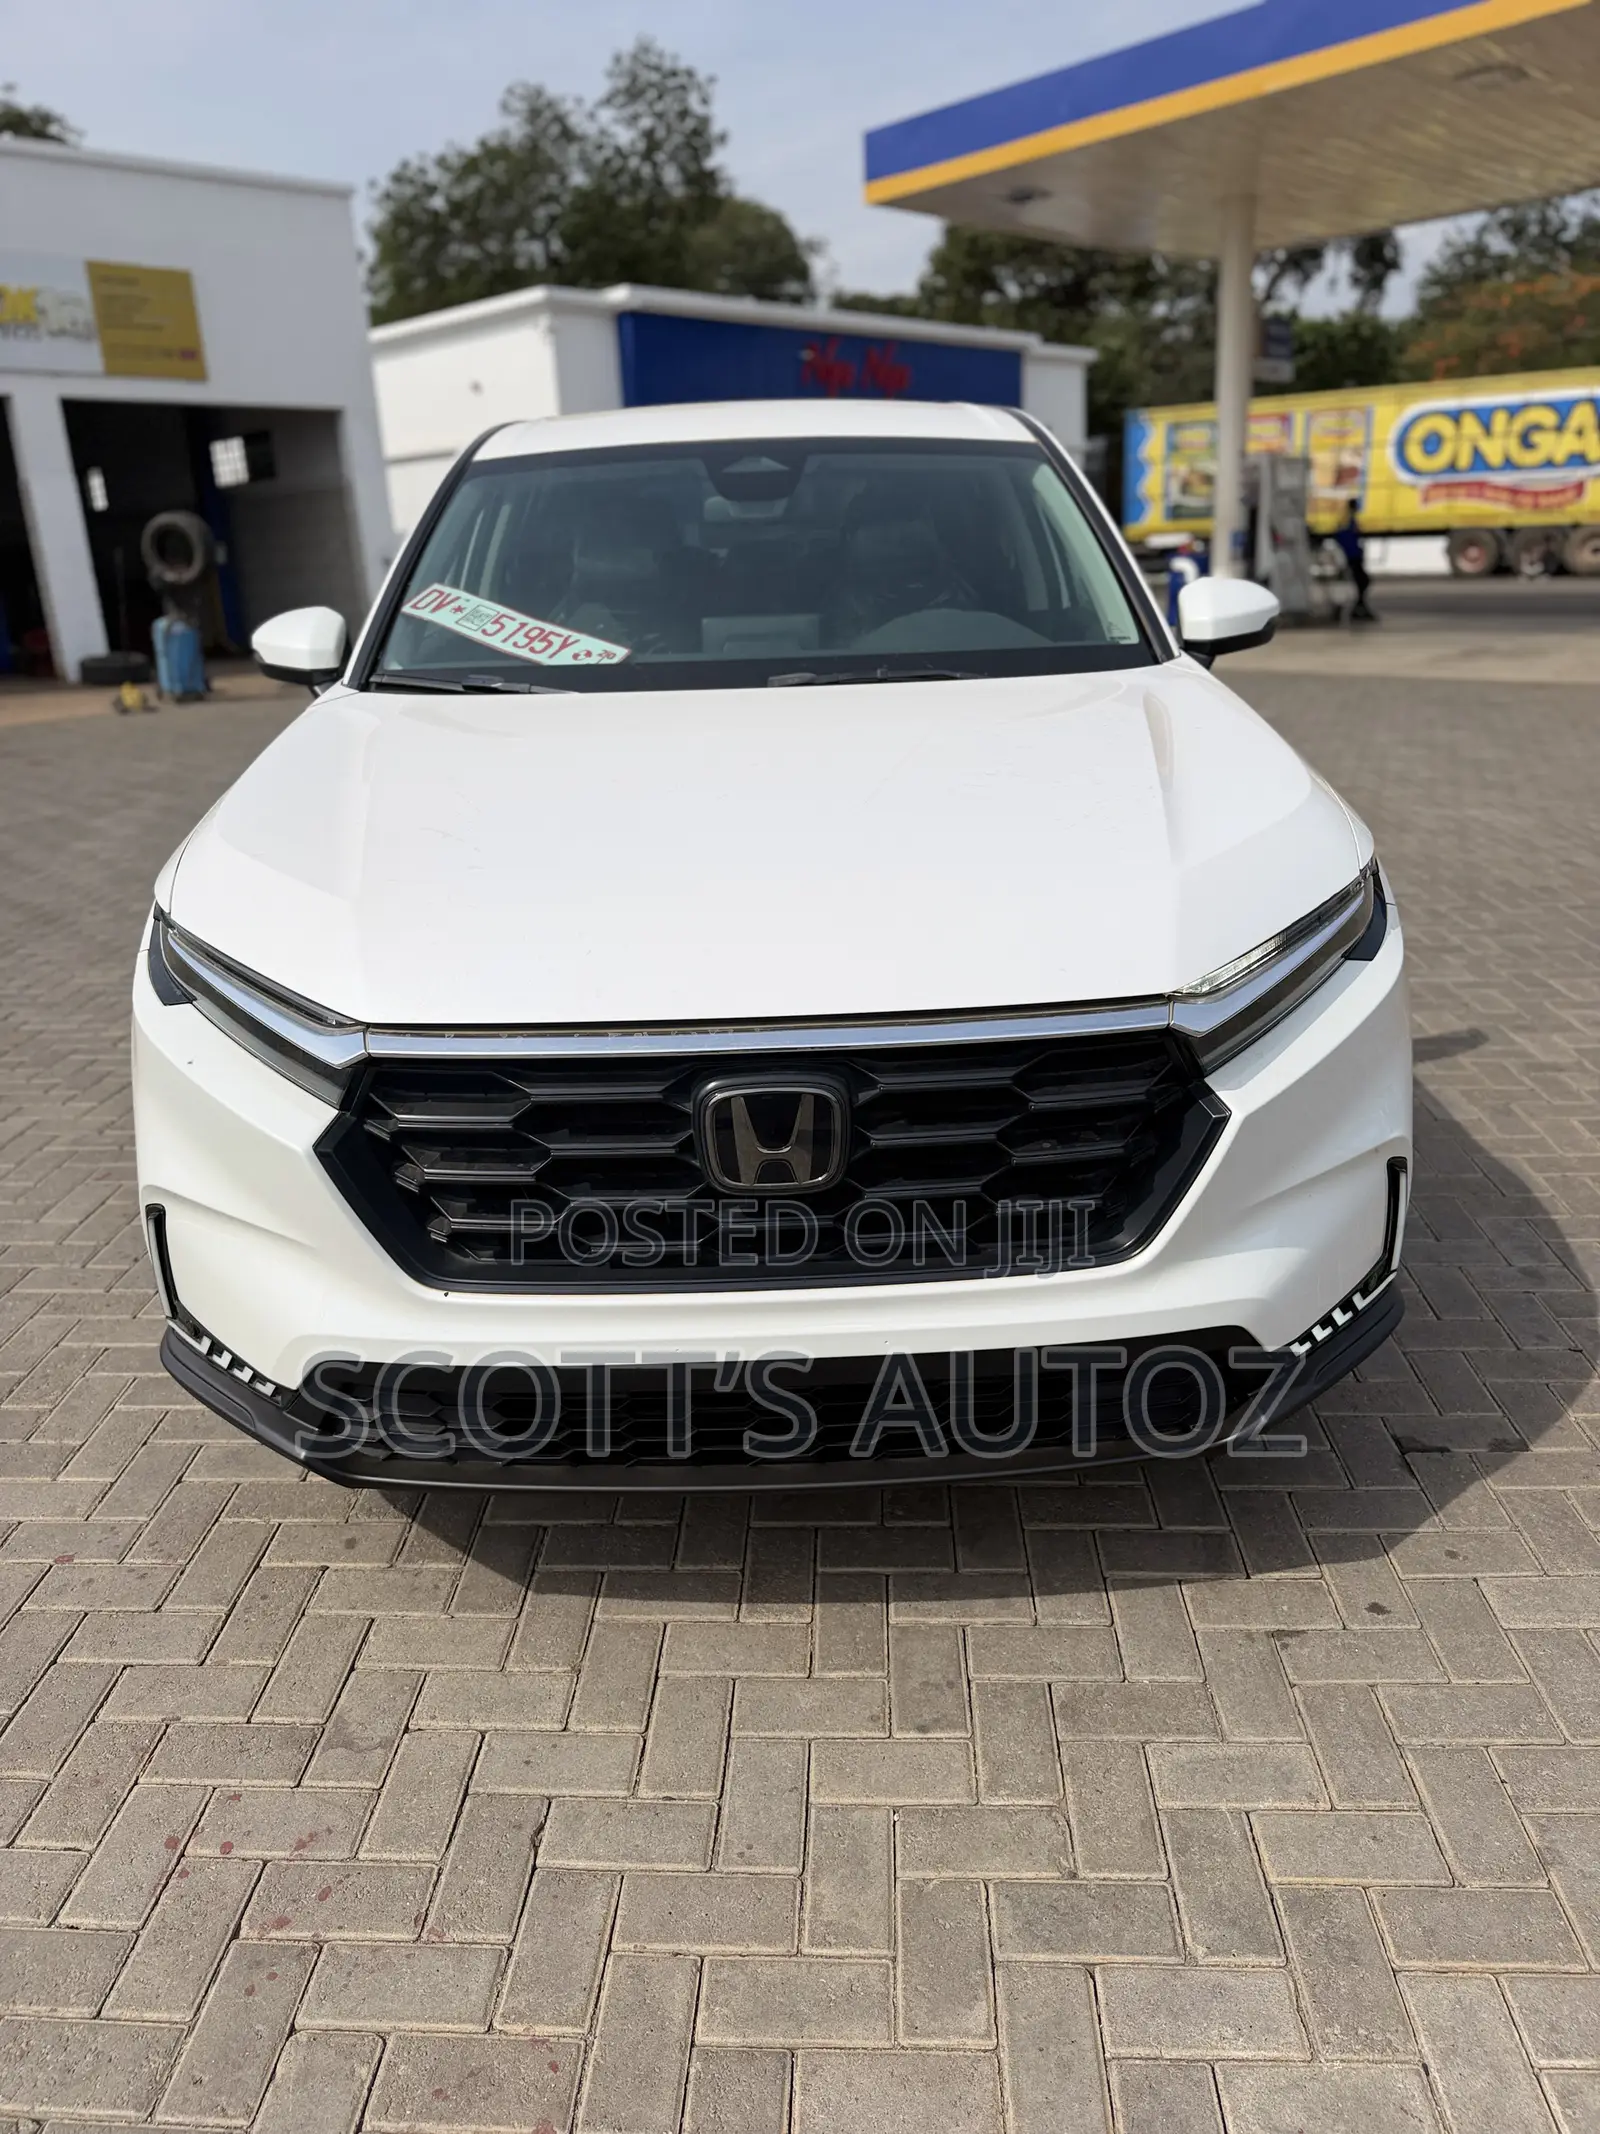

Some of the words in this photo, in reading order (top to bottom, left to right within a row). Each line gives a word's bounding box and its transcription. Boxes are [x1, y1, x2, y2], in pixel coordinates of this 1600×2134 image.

[1404, 401, 1600, 474] ONGA
[410, 589, 462, 614] DV
[481, 613, 580, 659] 5195Y
